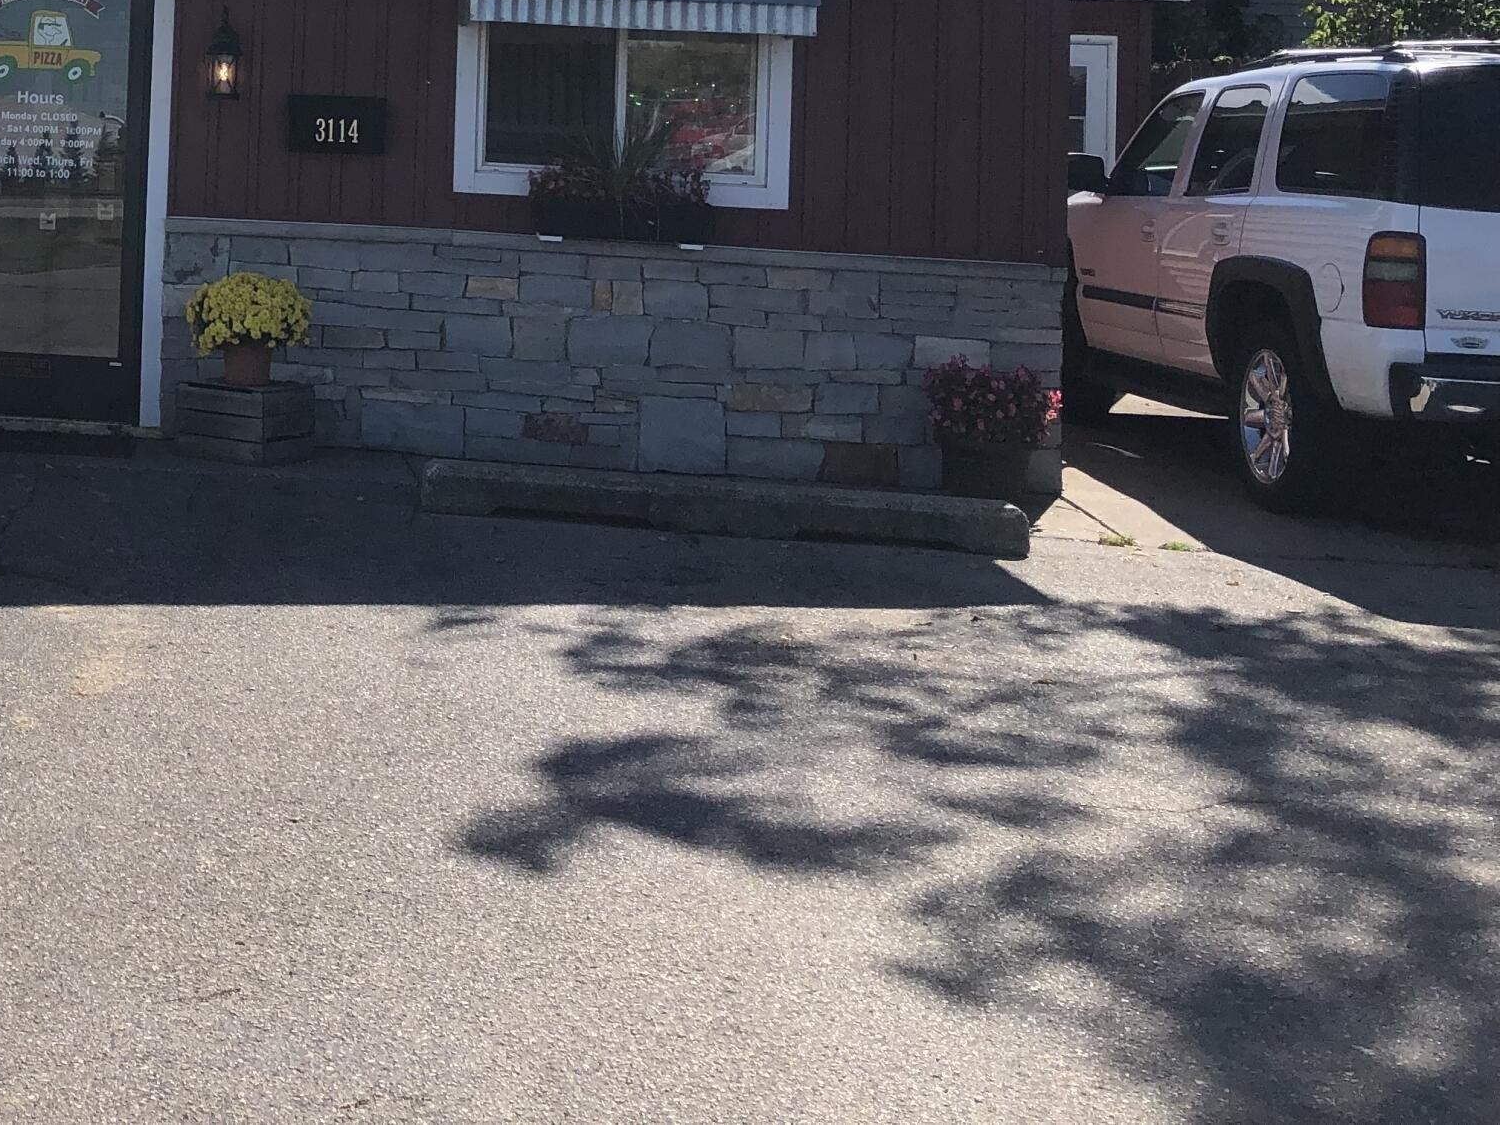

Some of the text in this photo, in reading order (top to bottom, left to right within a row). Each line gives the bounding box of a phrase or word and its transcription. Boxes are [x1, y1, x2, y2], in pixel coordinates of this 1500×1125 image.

[33, 50, 62, 66] PIZZA
[17, 90, 65, 105] Hours
[1, 110, 78, 123] Monday CLOSED
[6, 124, 23, 133] Sat
[315, 118, 359, 143] 3114
[19, 137, 54, 147] 4:00PM
[59, 139, 94, 149] 9:00PM
[45, 155, 77, 168] Thurs,
[80, 157, 94, 167] Fri
[6, 167, 70, 179] 11:00 to 1:00
